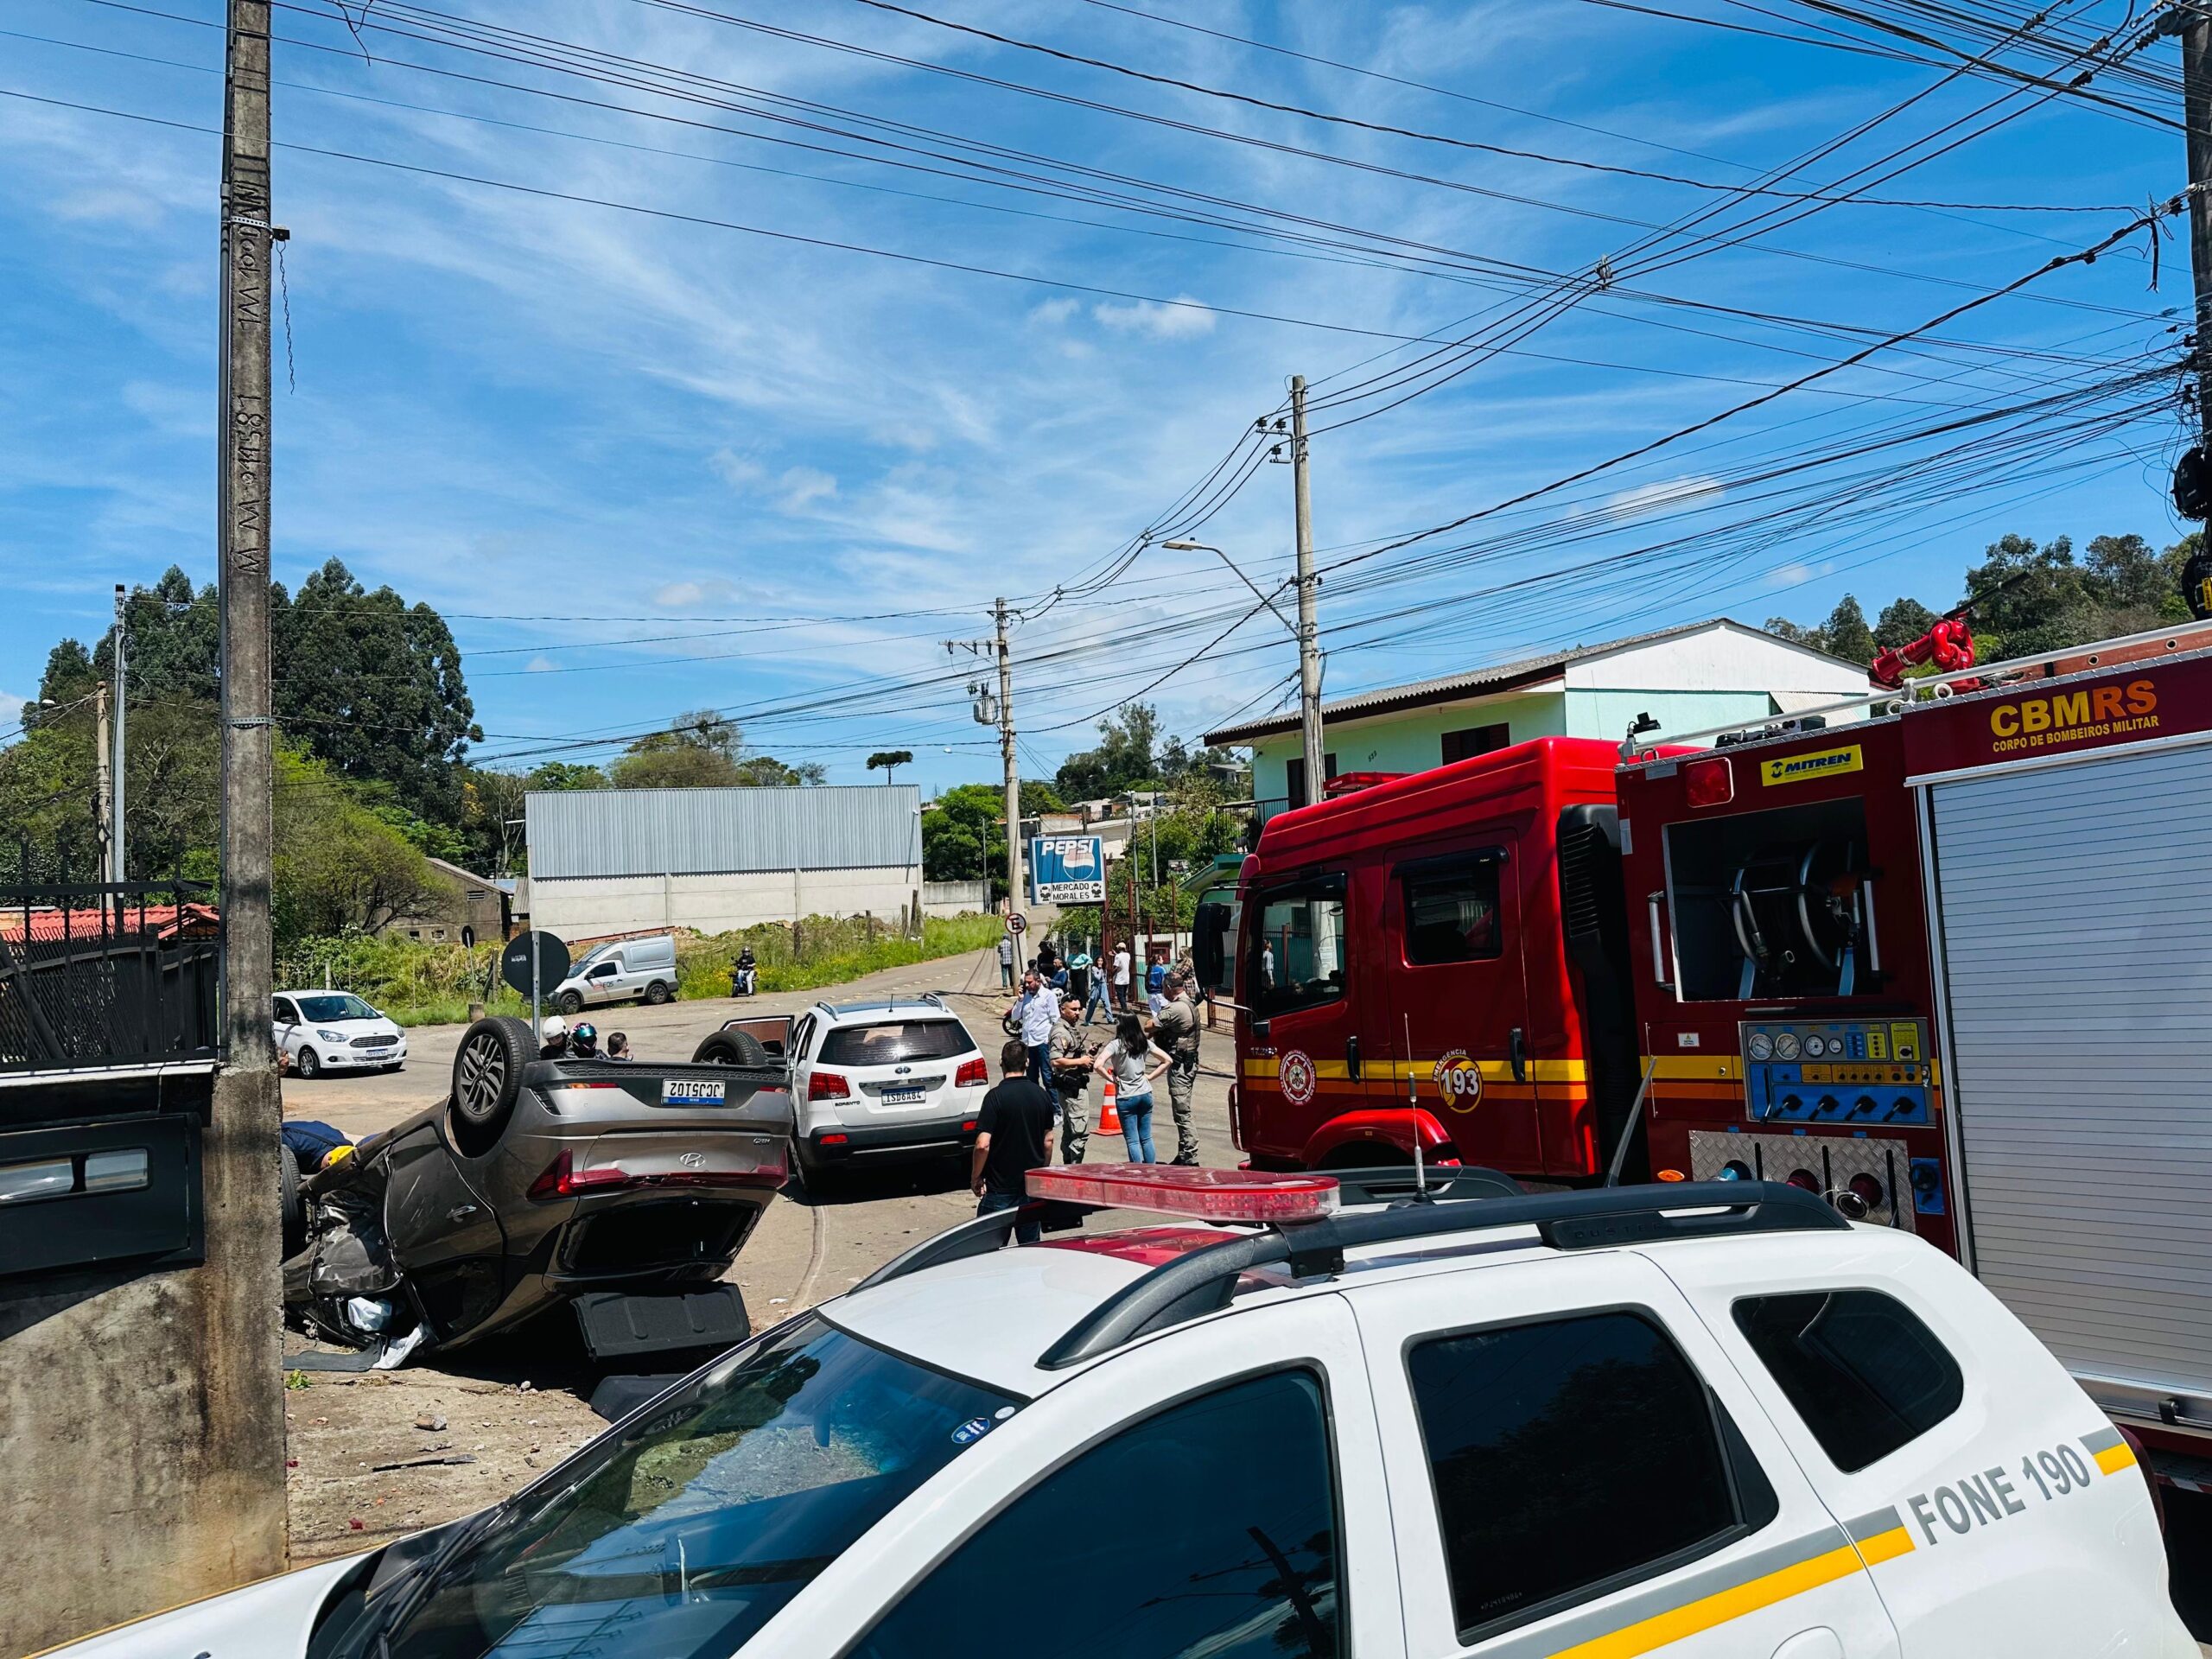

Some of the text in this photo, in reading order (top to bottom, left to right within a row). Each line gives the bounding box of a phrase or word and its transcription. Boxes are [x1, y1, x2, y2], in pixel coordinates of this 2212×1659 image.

[1990, 679, 2158, 737] CBMRS
[1993, 715, 2159, 753] CORPO DE BOMBEIROS MILITAR
[1784, 753, 1852, 772] MITREN
[1041, 839, 1094, 856] PEPSI
[1052, 882, 1090, 892] MERCADO
[1052, 892, 1090, 900] MORALES
[1011, 917, 1020, 931] E
[1440, 1068, 1479, 1096] 193
[1906, 1443, 2091, 1546] FONE 190
